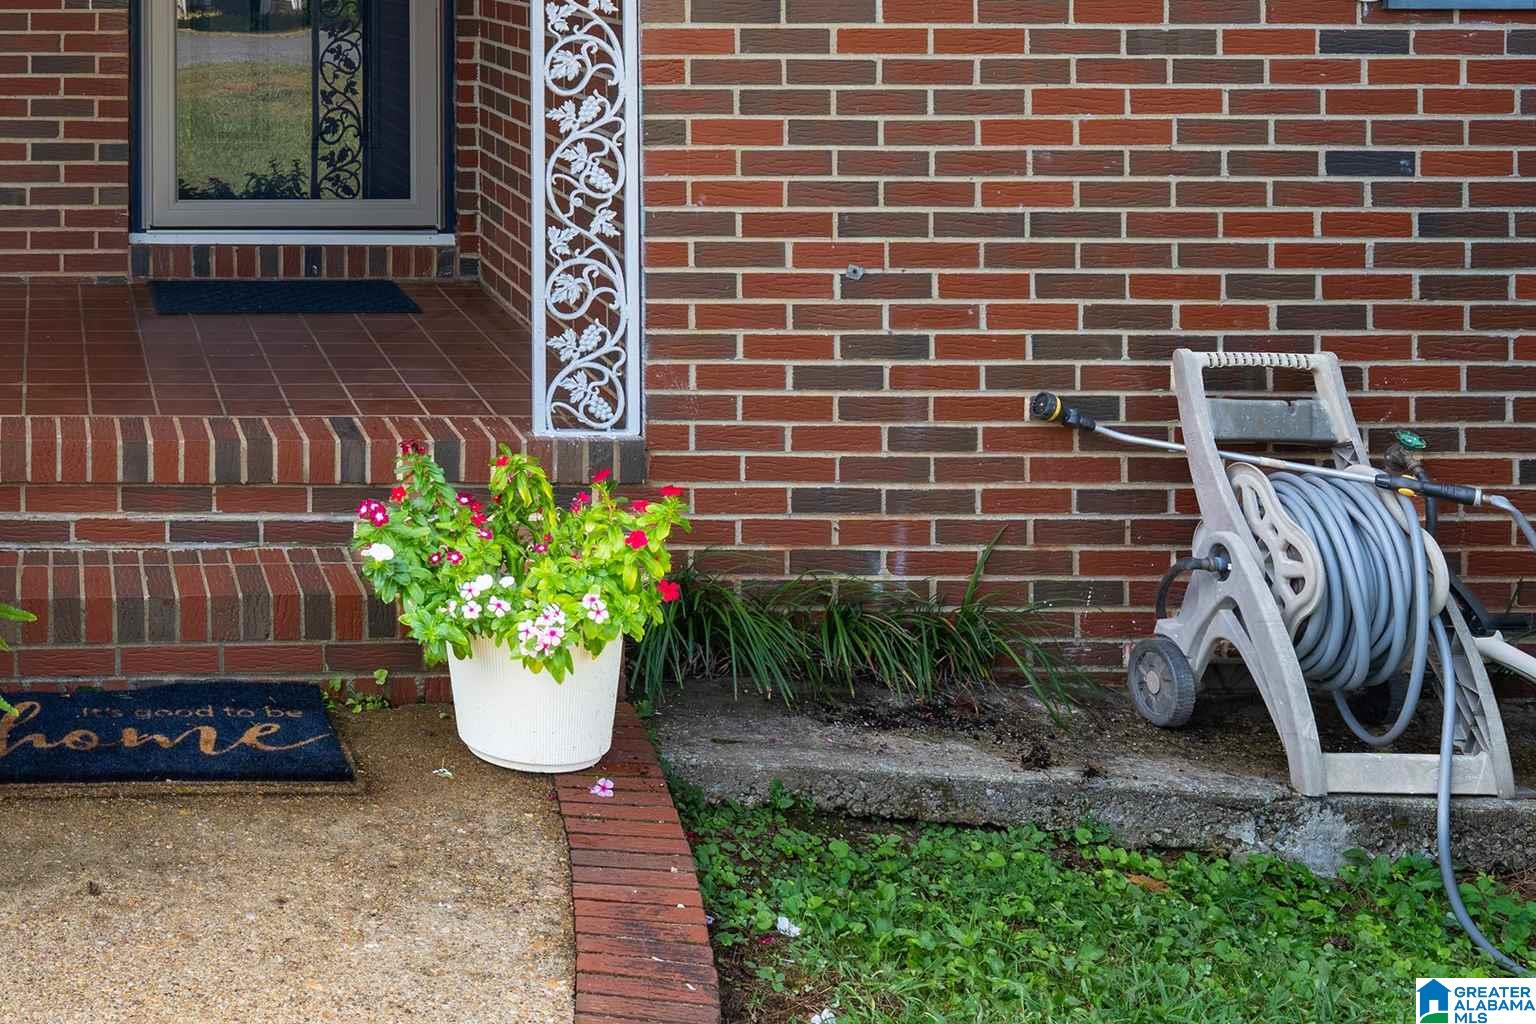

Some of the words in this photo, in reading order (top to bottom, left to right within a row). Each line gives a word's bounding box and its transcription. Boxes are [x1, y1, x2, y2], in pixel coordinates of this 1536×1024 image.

[134, 704, 214, 720] good
[223, 705, 255, 718] to
[264, 704, 304, 719] be
